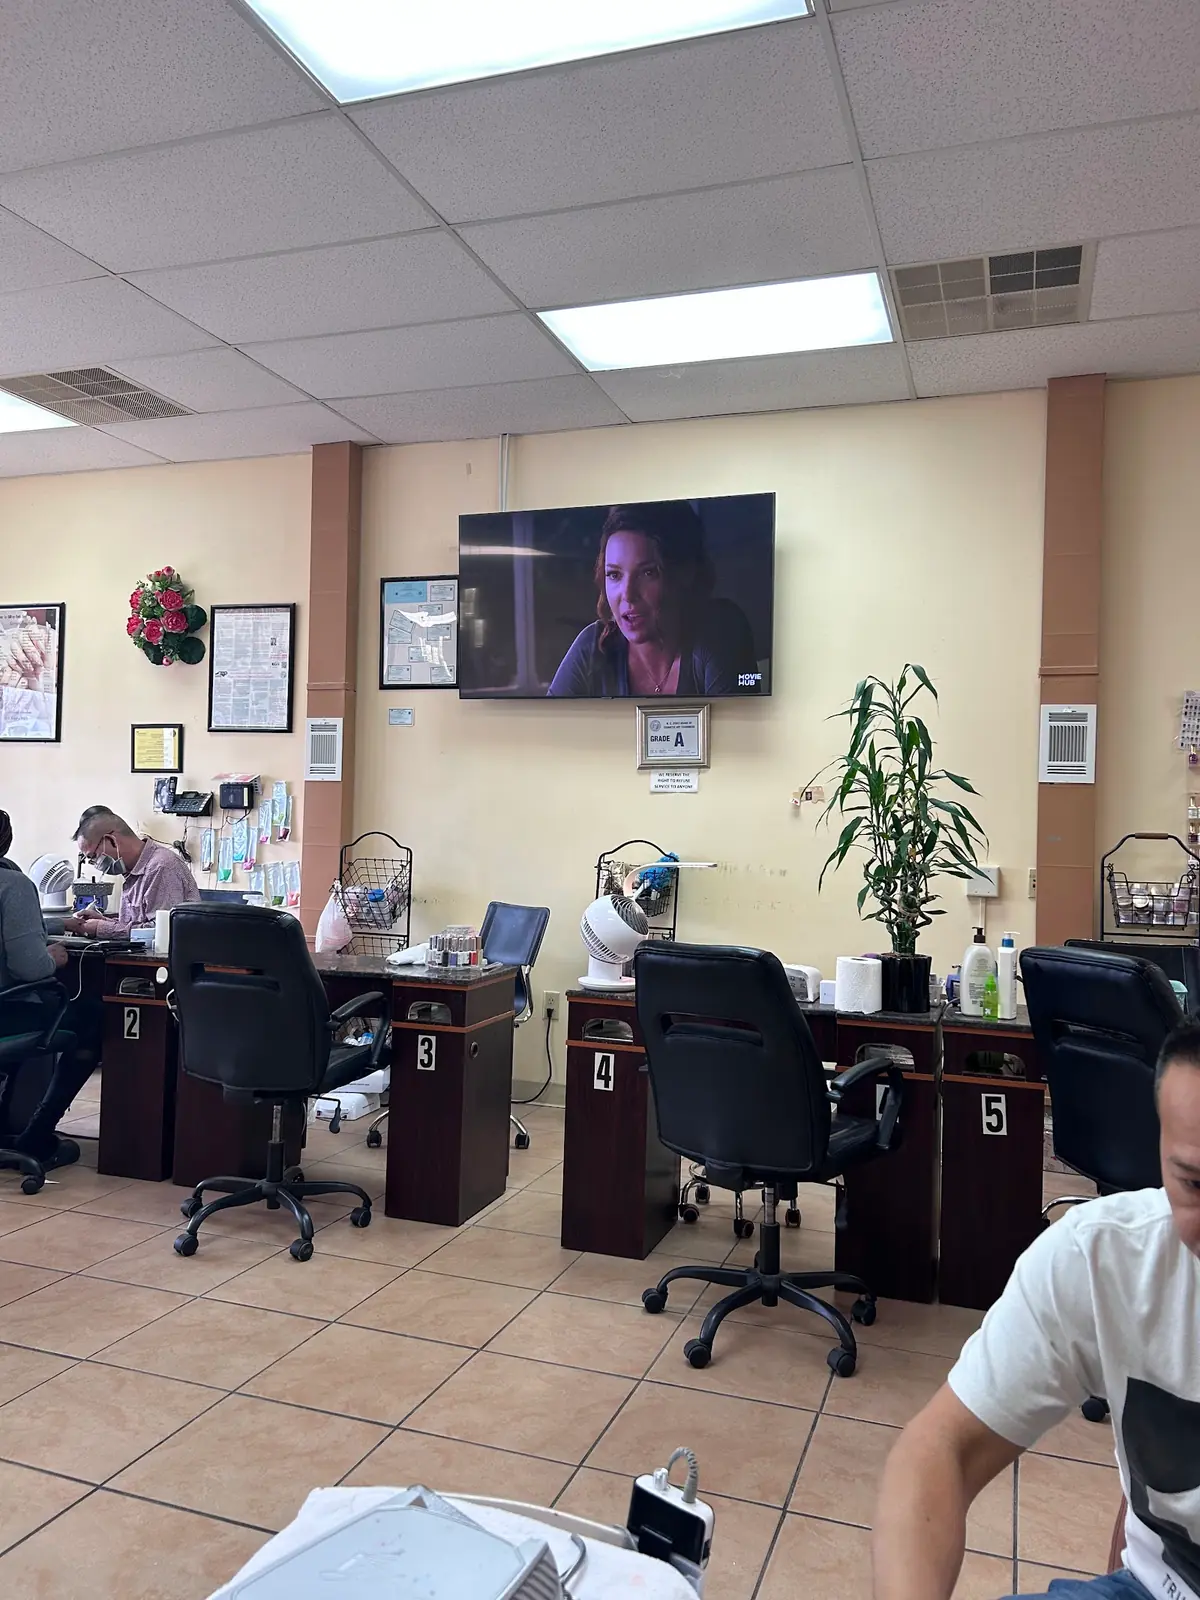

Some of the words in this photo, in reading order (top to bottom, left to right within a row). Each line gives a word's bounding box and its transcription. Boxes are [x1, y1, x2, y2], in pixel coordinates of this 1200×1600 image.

[674, 732, 684, 747] A
[126, 1008, 138, 1038] 2
[419, 1036, 434, 1069] 3
[596, 1054, 612, 1089] 4
[984, 1095, 1004, 1134] 5
